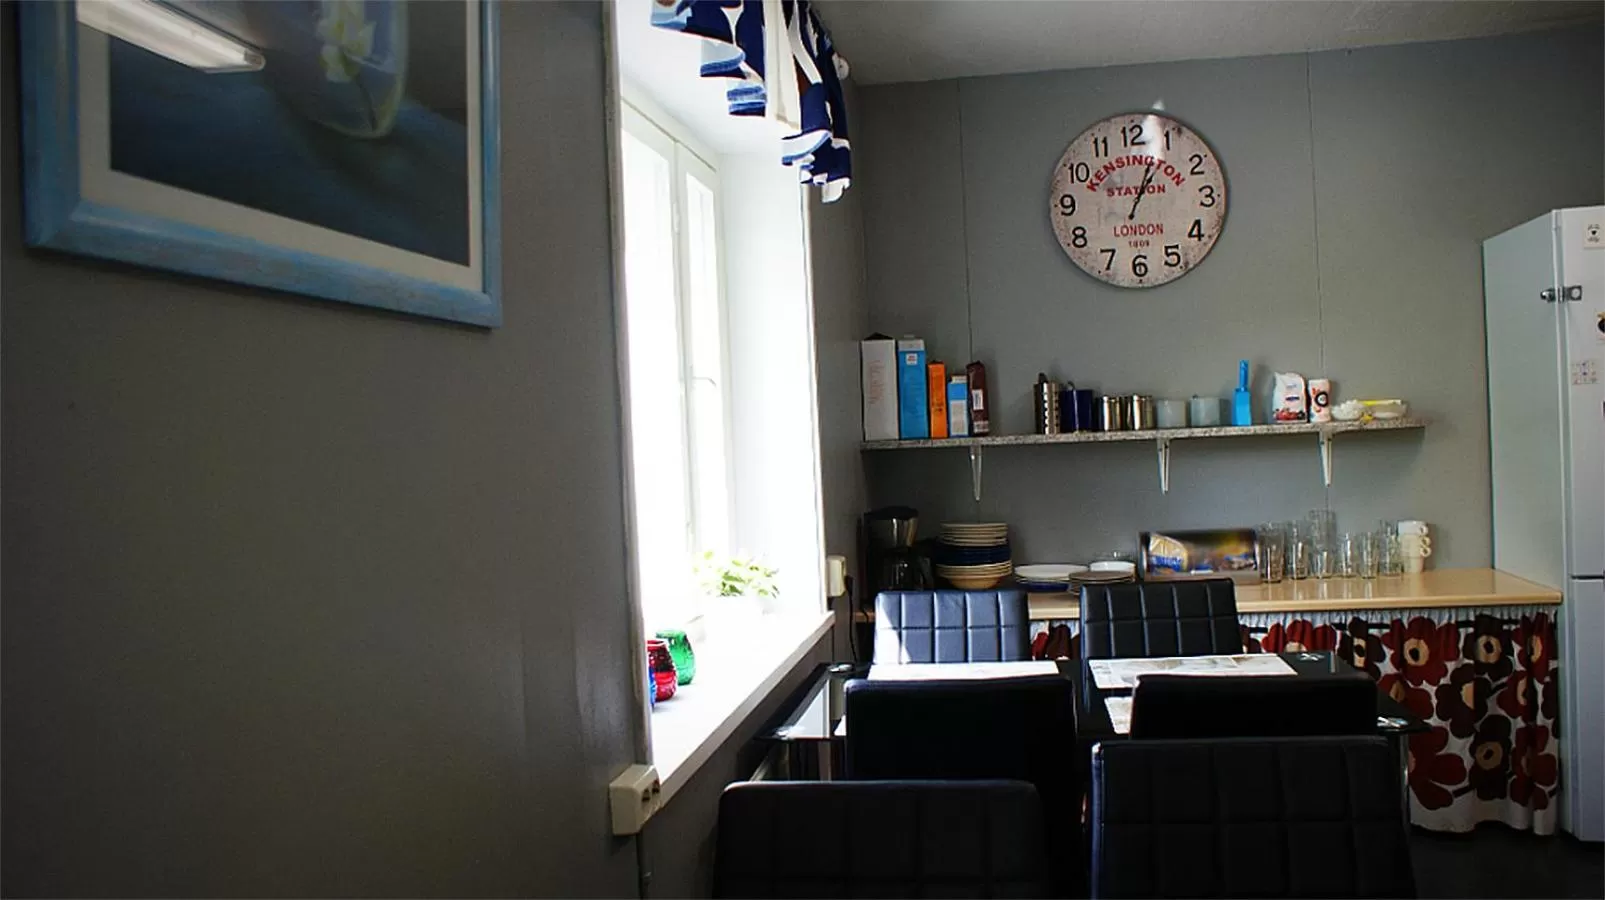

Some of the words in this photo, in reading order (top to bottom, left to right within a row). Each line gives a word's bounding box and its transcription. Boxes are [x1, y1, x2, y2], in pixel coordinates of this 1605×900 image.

[1093, 136, 1108, 157] 11
[1121, 125, 1145, 147] 12
[1165, 130, 1170, 150] 1
[1069, 162, 1089, 184] 10
[1087, 155, 1185, 192] KENSINGTON
[1189, 154, 1204, 175] 2
[1106, 184, 1165, 197] STATON
[1199, 185, 1215, 207] 3
[1060, 194, 1075, 216] 9
[1072, 227, 1087, 248] 8
[1114, 224, 1163, 237] LONDON
[1188, 220, 1204, 241] 4
[1100, 248, 1116, 270] 7
[1132, 255, 1148, 277] 6
[1164, 245, 1181, 267] 5
